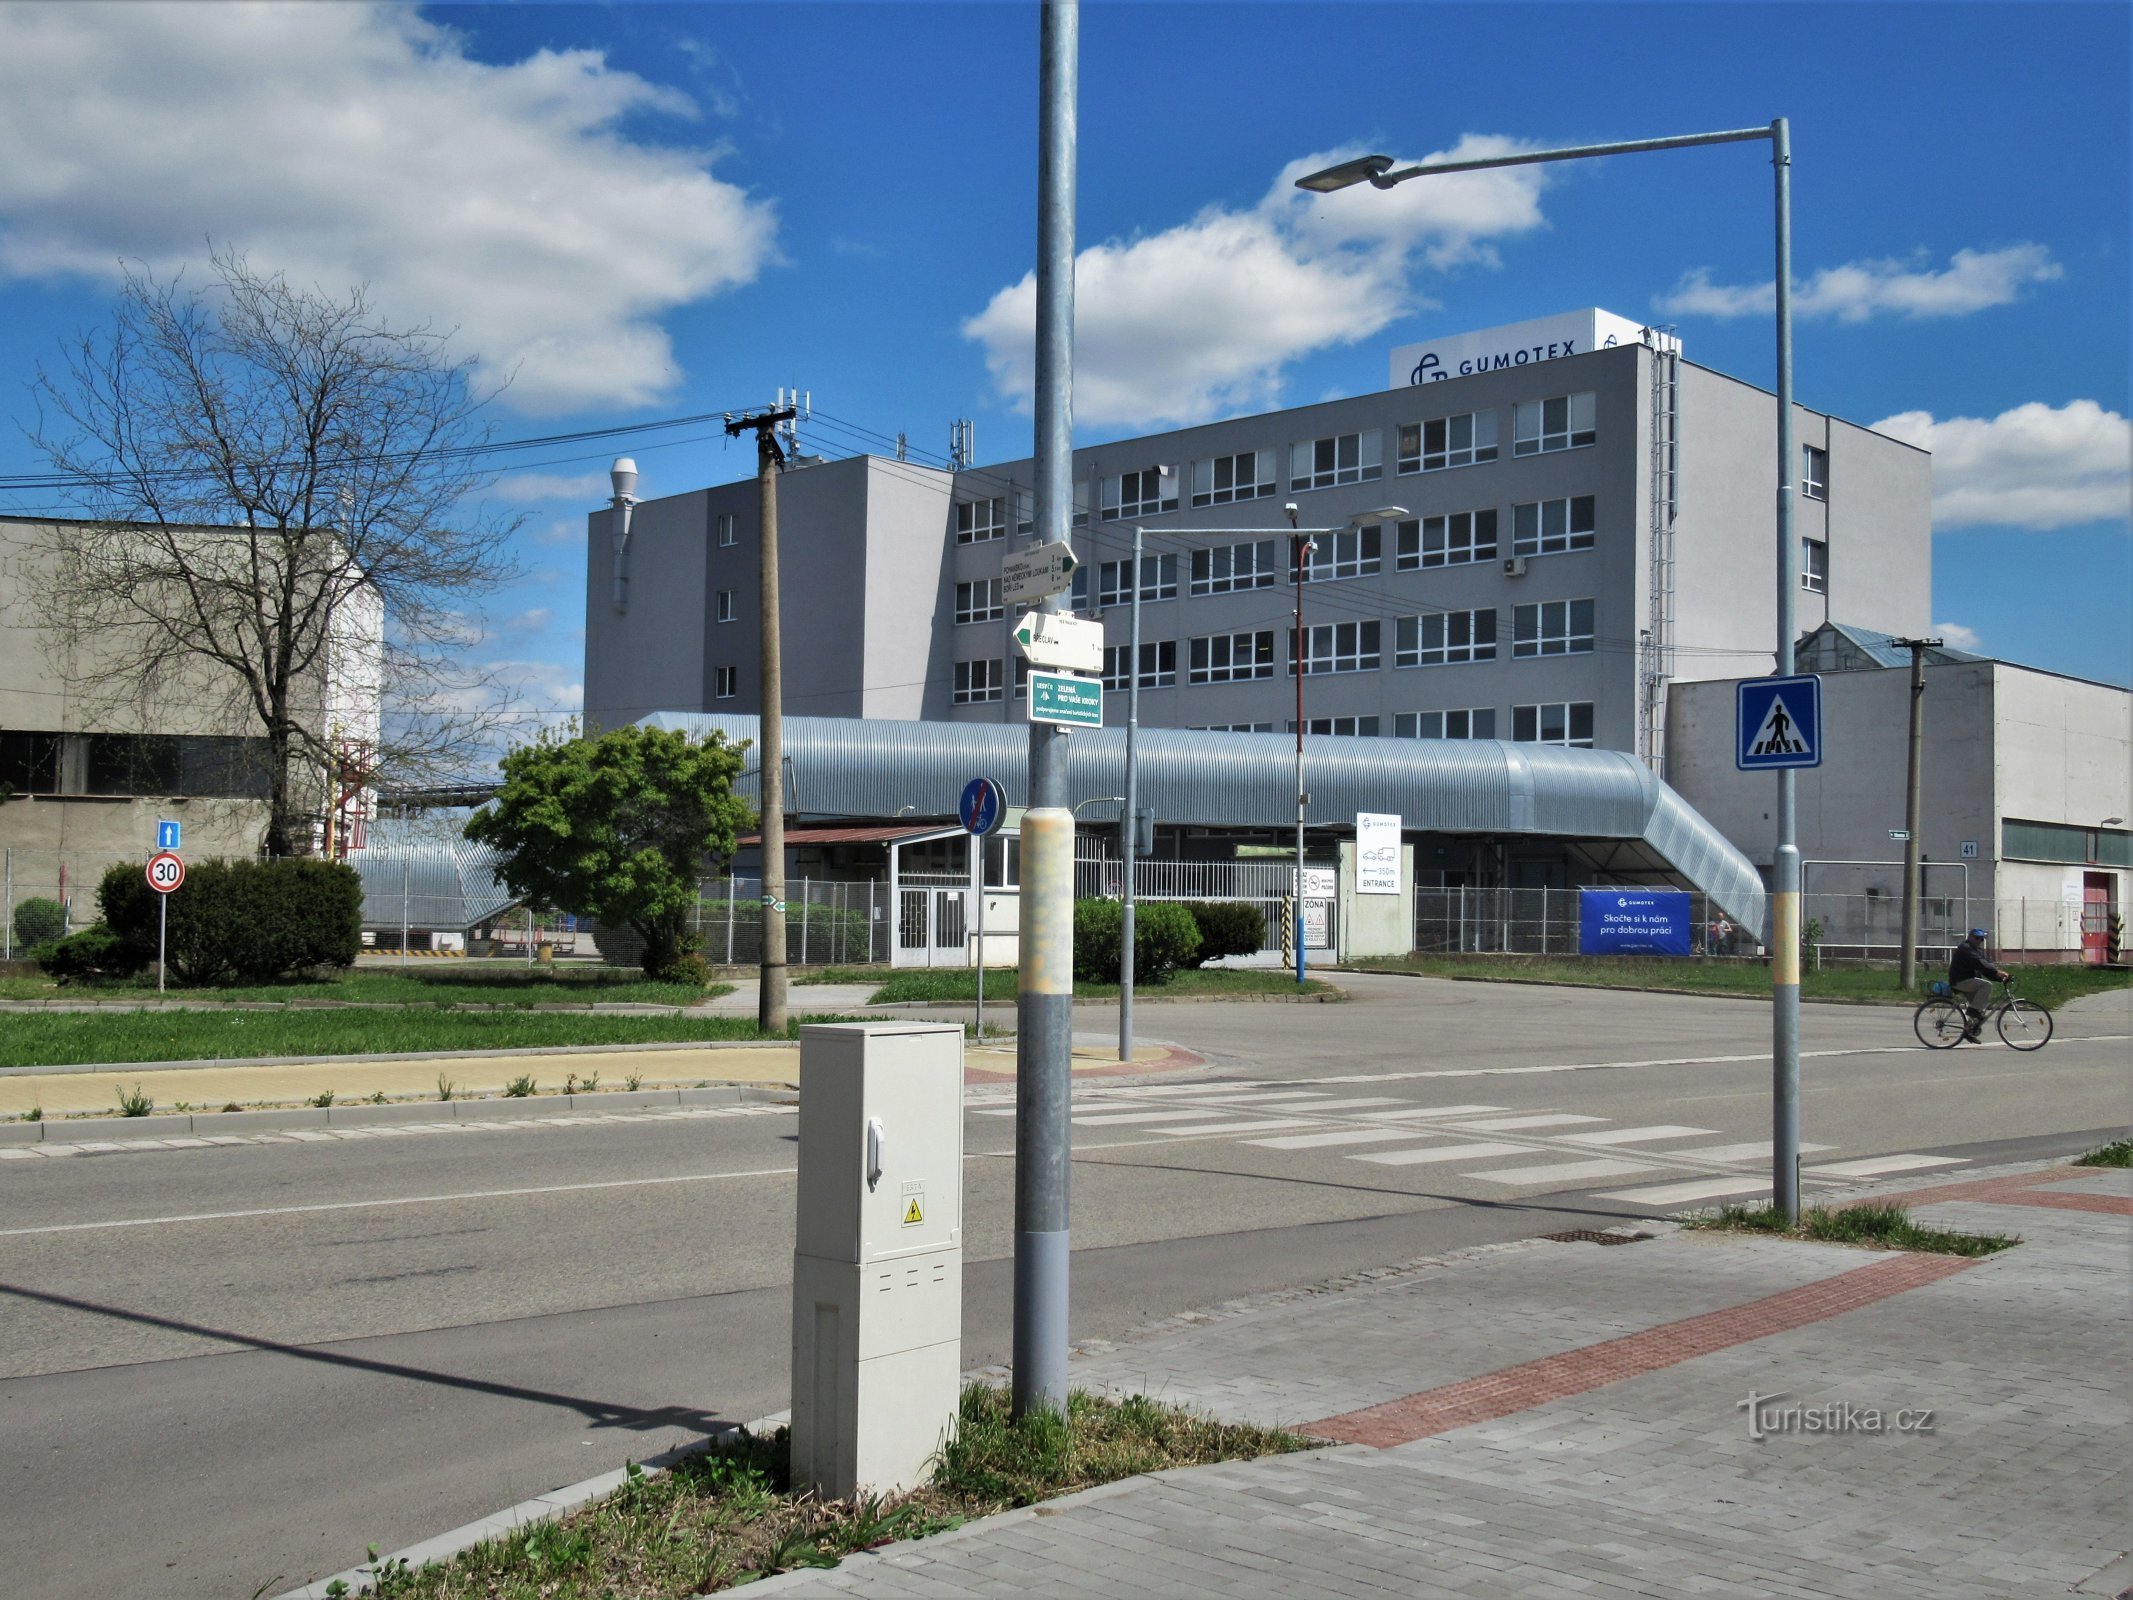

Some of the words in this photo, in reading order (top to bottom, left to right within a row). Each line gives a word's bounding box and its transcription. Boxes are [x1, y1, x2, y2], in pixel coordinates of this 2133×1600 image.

[1459, 340, 1575, 376] GUMOTEX
[1033, 633, 1054, 644] BŘECLAV
[1057, 684, 1076, 694] ZELENÁ
[1057, 694, 1068, 702] PRO
[1069, 694, 1081, 704] VAŠE
[1082, 697, 1099, 706] KROKY
[1963, 844, 1974, 855] 41
[155, 863, 177, 882] 30
[1363, 879, 1396, 888] ENTRANCE
[1604, 914, 1632, 923] Skočte
[1633, 914, 1641, 923] si
[1642, 914, 1648, 923] k
[1649, 914, 1668, 923] nám
[1600, 927, 1616, 935] pro
[1617, 925, 1649, 934] dobrou
[1650, 926, 1672, 936] práci
